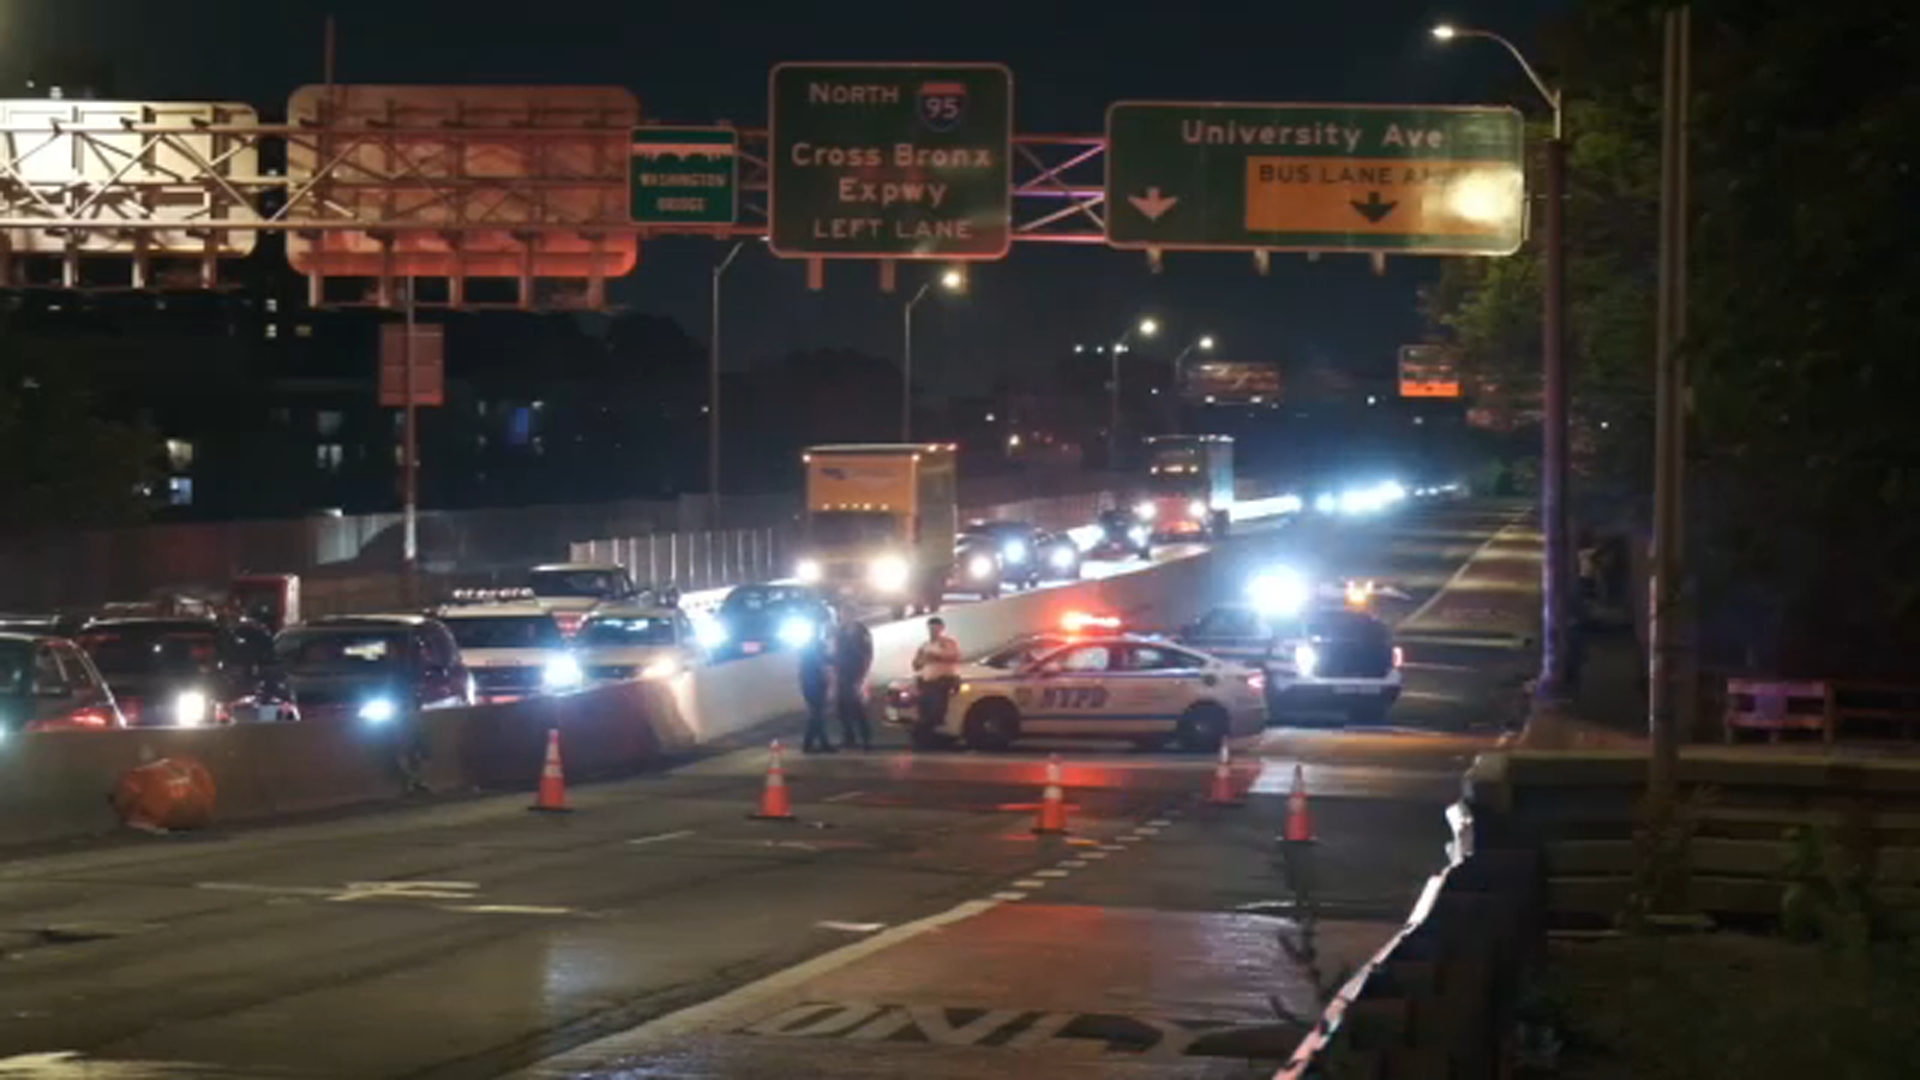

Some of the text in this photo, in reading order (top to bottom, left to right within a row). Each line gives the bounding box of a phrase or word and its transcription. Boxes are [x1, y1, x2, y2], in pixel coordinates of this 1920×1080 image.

[808, 82, 899, 104] NORTH
[924, 97, 959, 118] 95
[1181, 119, 1445, 150] University Ave
[790, 142, 992, 167] Cross Bronx
[1258, 164, 1310, 183] BUS
[1320, 166, 1393, 185] LANE
[838, 176, 949, 208] Expwy
[813, 218, 974, 240] LEFT LANE
[1040, 684, 1108, 709] NYPD
